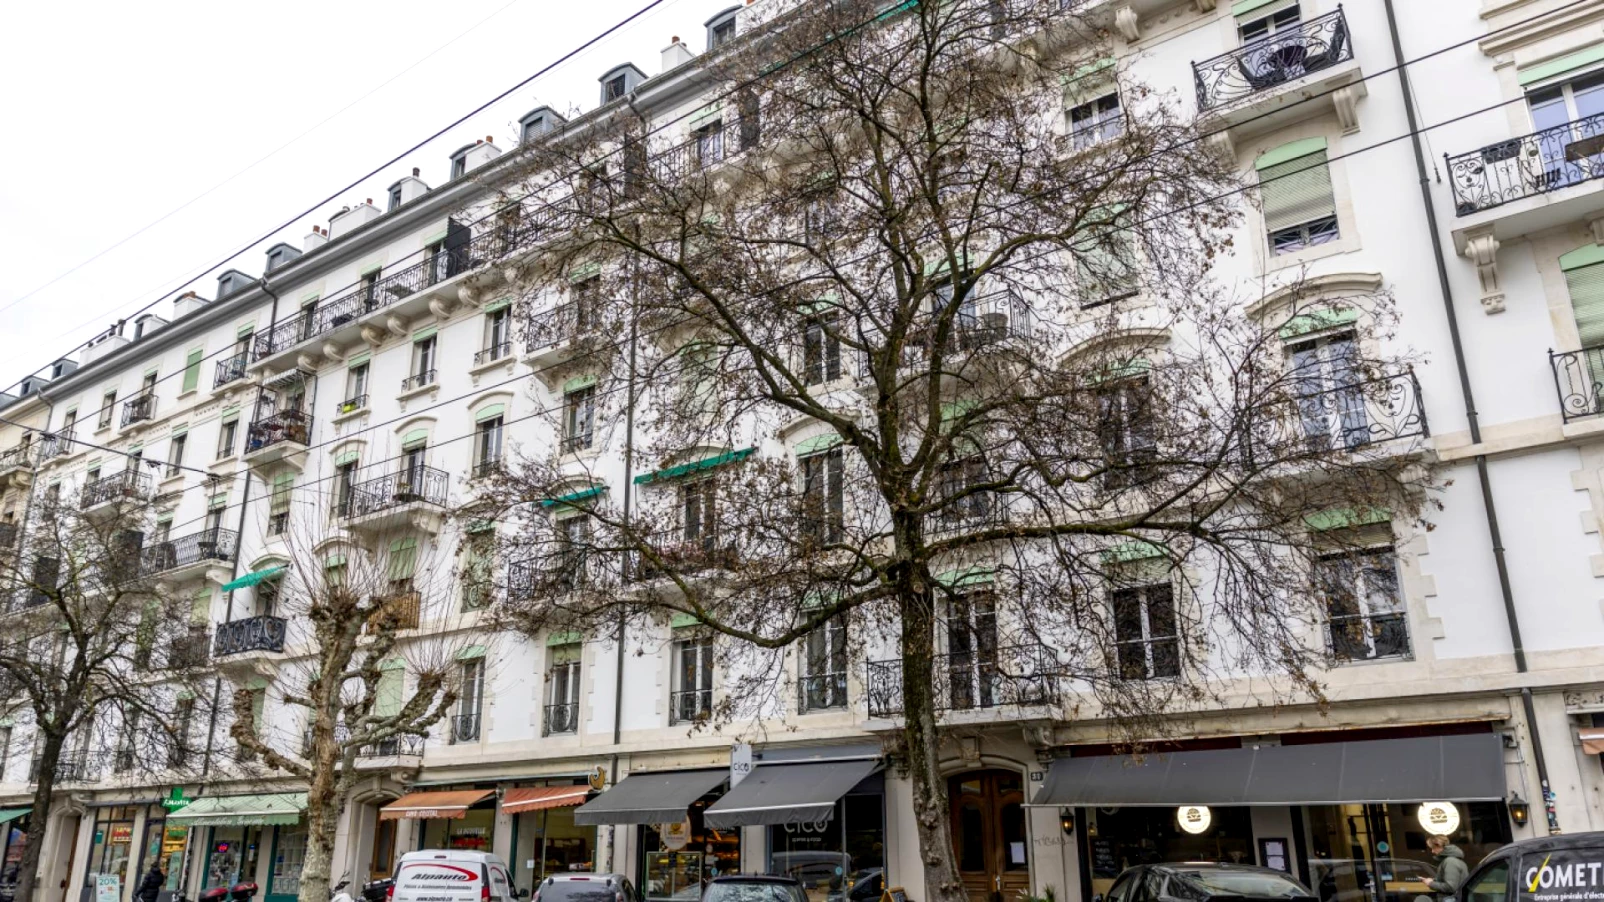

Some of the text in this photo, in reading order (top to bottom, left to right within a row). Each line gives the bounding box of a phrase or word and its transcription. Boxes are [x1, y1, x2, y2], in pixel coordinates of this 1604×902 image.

[412, 873, 467, 881] Alpauto
[1526, 862, 1604, 888] COMET
[1560, 893, 1582, 901] générale
[1584, 891, 1604, 899] d'élect
